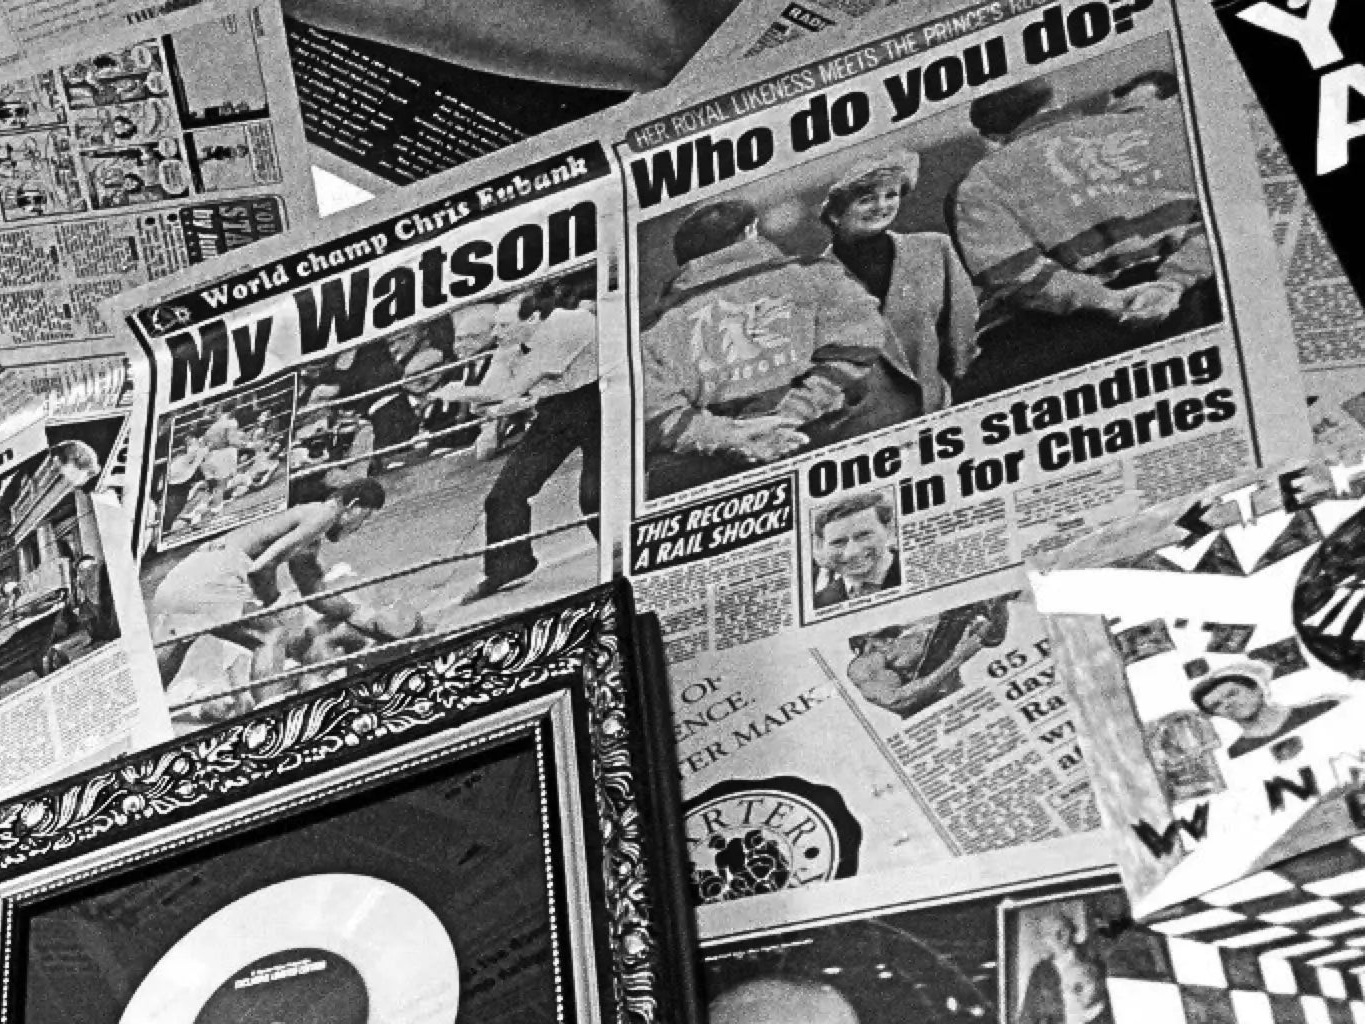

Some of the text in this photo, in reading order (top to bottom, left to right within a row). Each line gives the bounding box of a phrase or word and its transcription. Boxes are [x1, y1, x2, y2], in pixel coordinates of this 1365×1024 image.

[631, 36, 1007, 209] Who do you
[635, 123, 671, 148] HER
[671, 102, 728, 136] ROYAL
[731, 70, 815, 114] LIKENESS
[819, 48, 879, 84] MEETS
[881, 32, 917, 59] THE
[201, 156, 587, 308] World champ Chris Eubank
[168, 197, 596, 402] My Watson
[809, 349, 1224, 498] One is standing
[899, 388, 1236, 516] in for Charles
[627, 506, 797, 570] A RAIL SHOCK!
[629, 484, 787, 546] THIS RECORD'S
[986, 649, 1027, 680] 65
